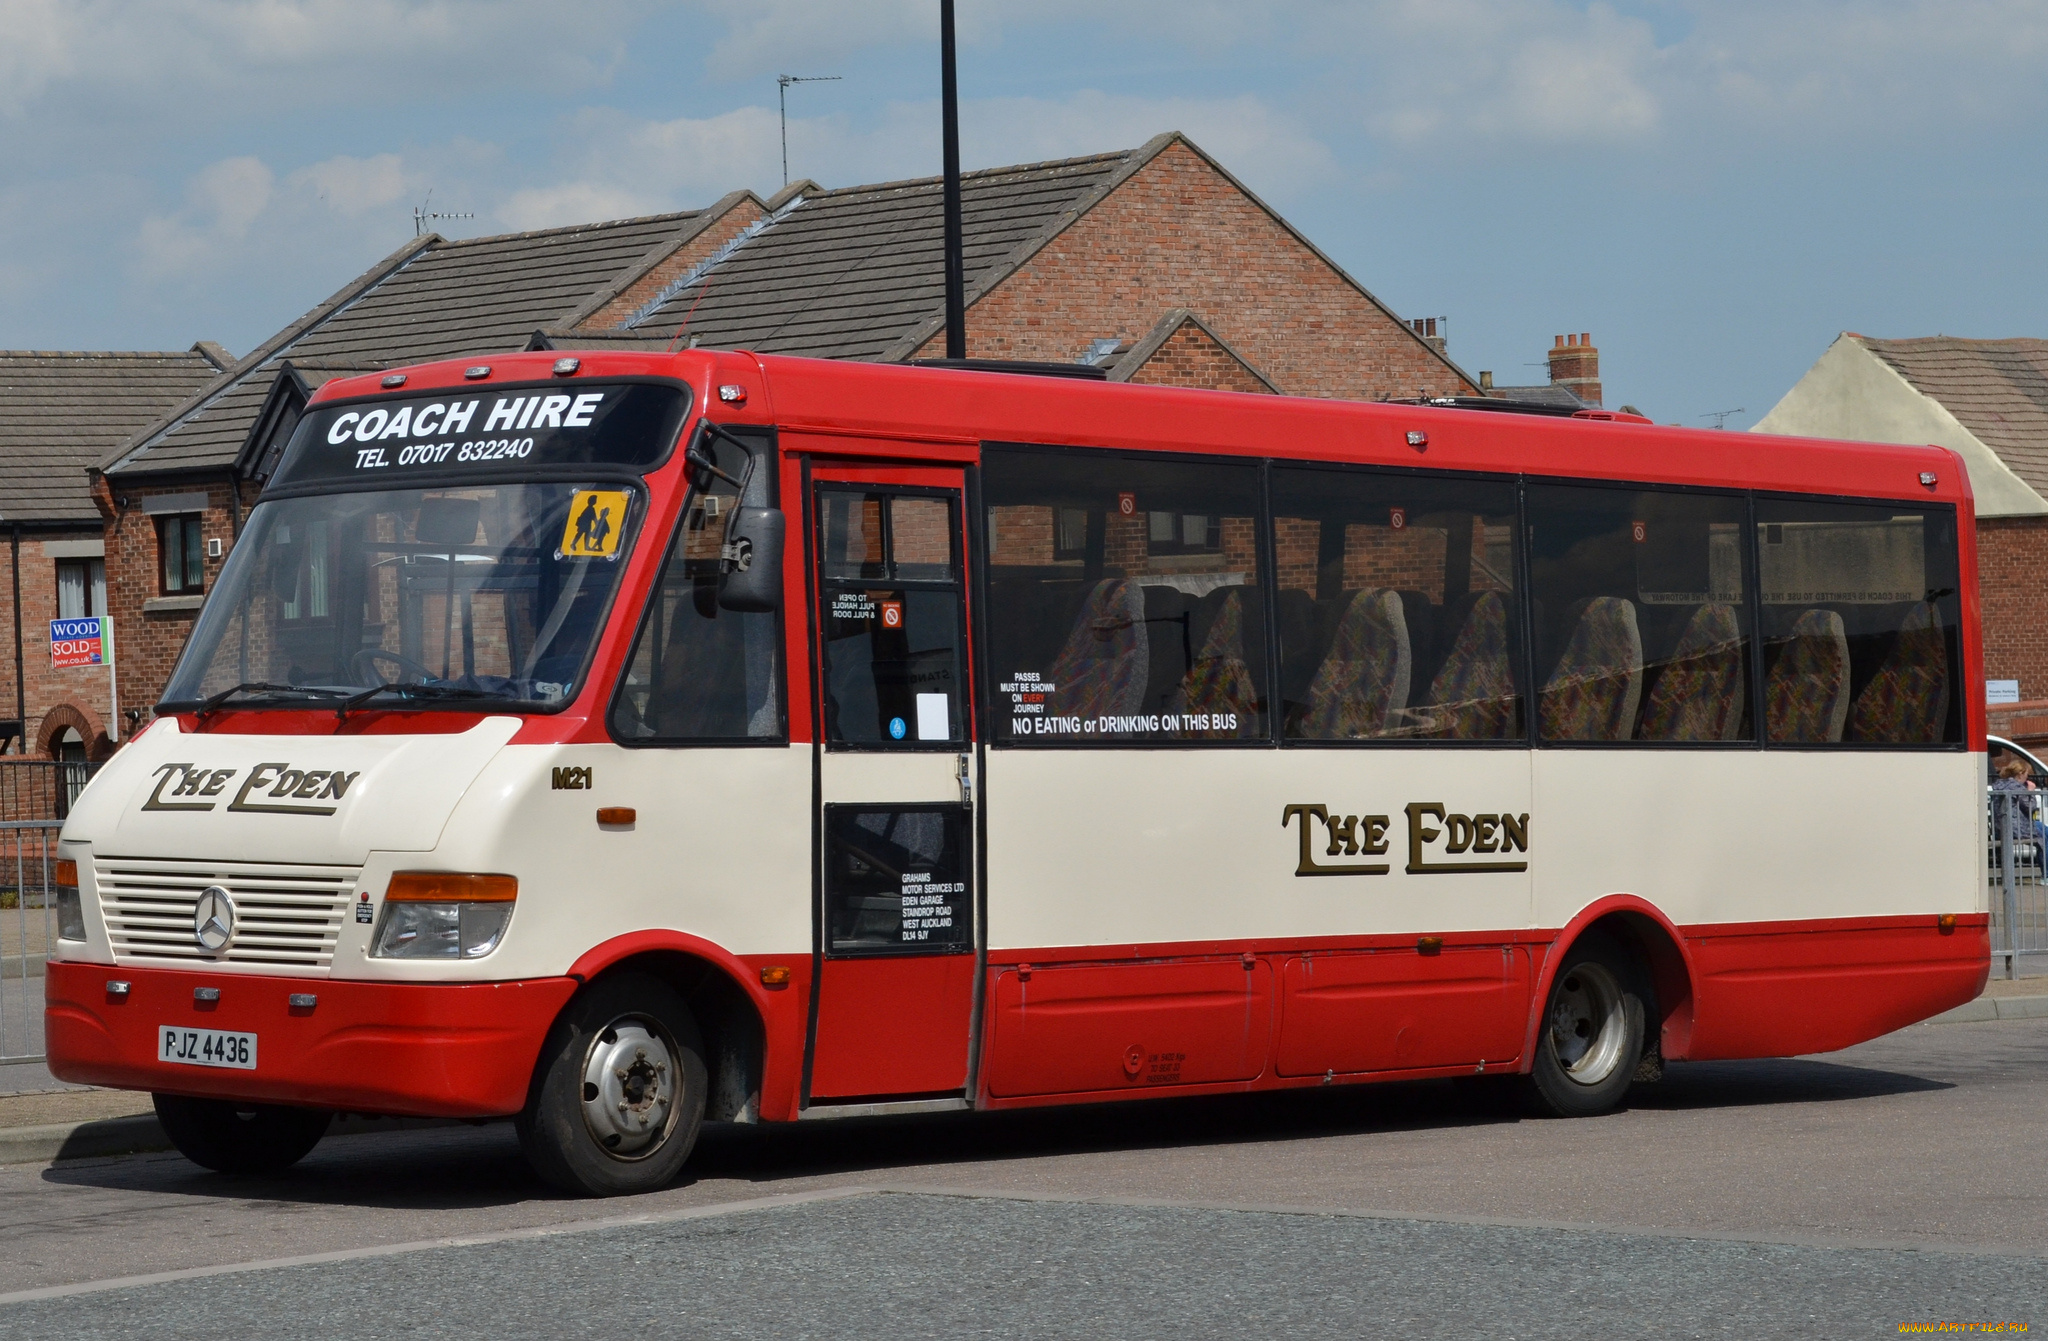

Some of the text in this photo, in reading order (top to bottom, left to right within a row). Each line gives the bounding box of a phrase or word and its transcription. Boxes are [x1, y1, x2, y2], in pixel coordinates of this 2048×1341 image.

[328, 393, 604, 444] COACH HIRE
[355, 438, 534, 468] TEL. 07017 832240
[52, 622, 99, 636] WOOD
[53, 641, 89, 656] SOLD
[1014, 672, 1040, 682] PASSES
[1000, 683, 1055, 692] MUST BE SHOWN
[1012, 694, 1044, 702] ON EVERY
[1013, 704, 1044, 713] JOURNEY
[1012, 713, 1237, 734] NO EATING or DRINKING ON THIS BUS
[552, 766, 592, 790] M21
[141, 762, 237, 811] THE
[1282, 803, 1390, 877] THE
[902, 873, 931, 883] GRAHAMS
[902, 883, 964, 894] MOTOR SERVICES LTD
[902, 895, 943, 906] EDEN GARAGE
[936, 906, 952, 915] ROAD
[903, 918, 952, 929] WEST AUCKLAND
[902, 930, 929, 940] DL14 9JY
[166, 1031, 249, 1063] PJZ 4436
